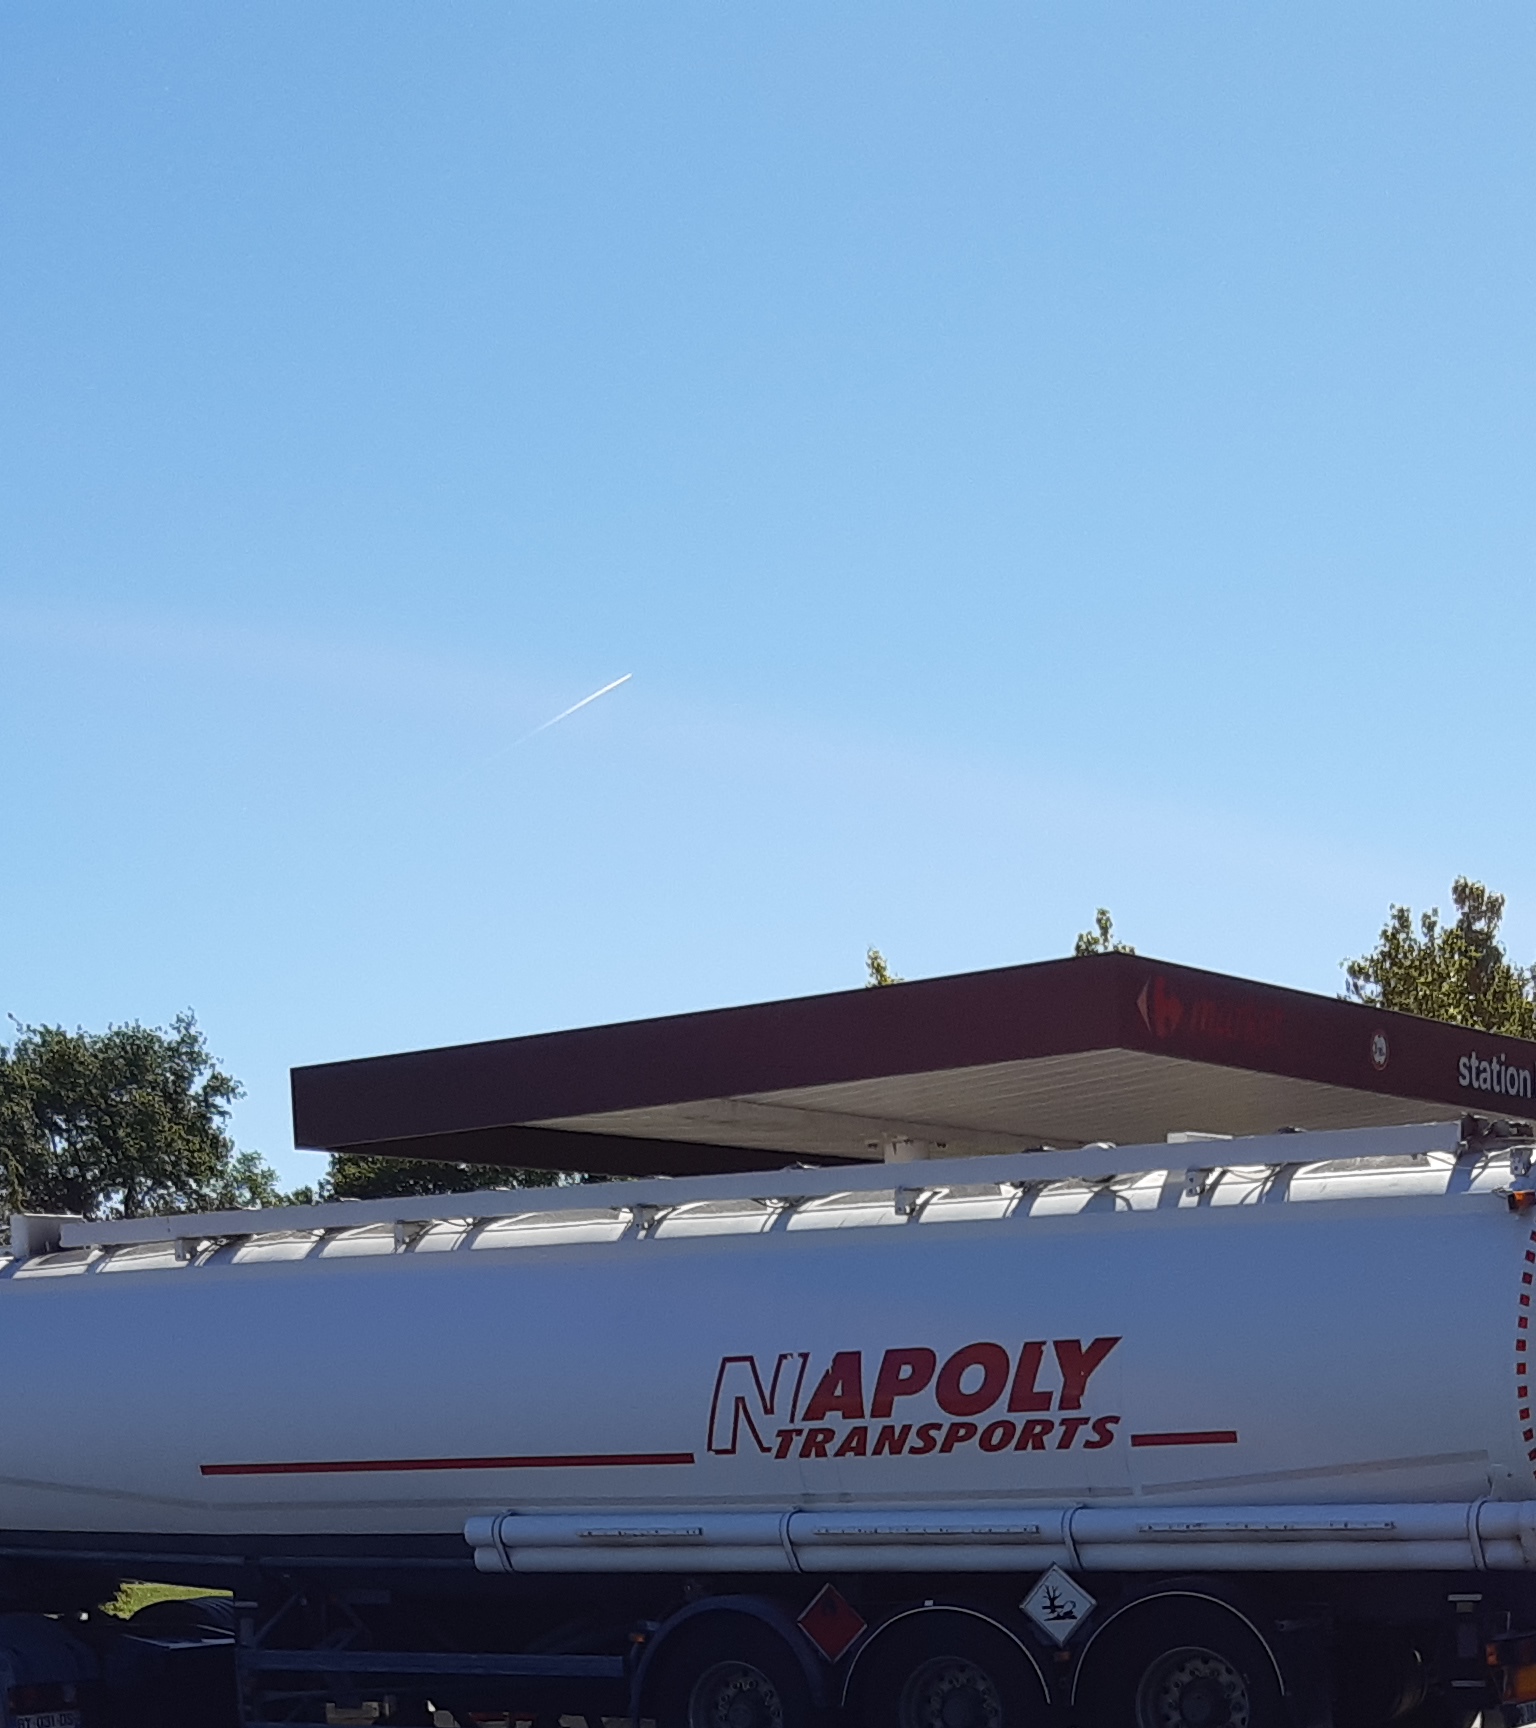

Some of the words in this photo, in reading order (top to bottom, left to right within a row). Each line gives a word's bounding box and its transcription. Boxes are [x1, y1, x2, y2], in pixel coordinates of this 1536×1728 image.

[1458, 1051, 1531, 1098] station
[707, 1336, 1122, 1455] NAPOLY
[774, 1416, 1121, 1459] TRANSPORTS
